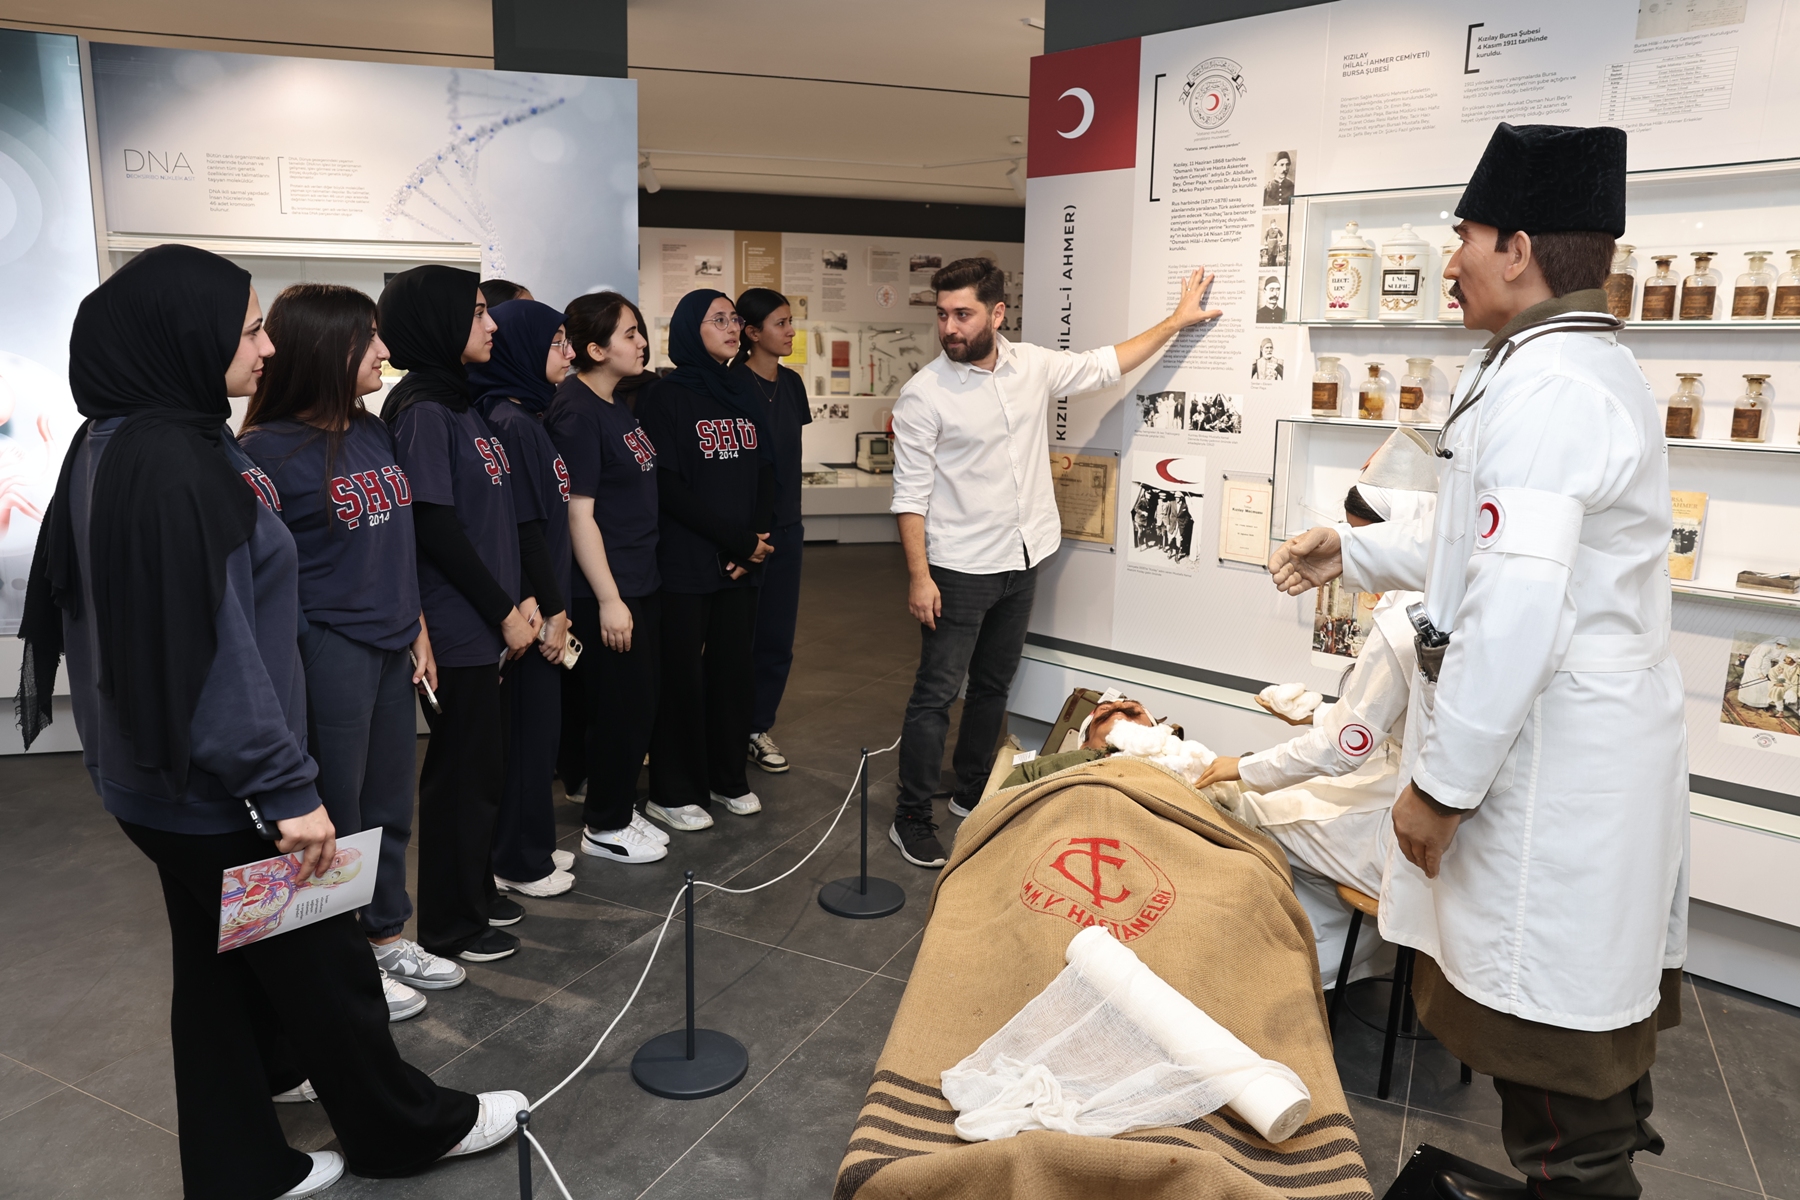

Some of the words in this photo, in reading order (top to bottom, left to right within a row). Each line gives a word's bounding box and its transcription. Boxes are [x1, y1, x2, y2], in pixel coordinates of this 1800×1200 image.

[1519, 27, 1540, 37] Şubesi
[1519, 35, 1548, 44] tarihinde
[1343, 59, 1368, 69] (HİLAL-İ
[1370, 57, 1394, 65] AHMER
[1396, 50, 1430, 62] CEMİYETİ)
[1344, 52, 1368, 60] KIZILAY
[1366, 64, 1389, 75] ŞUBESİ
[124, 149, 193, 174] DNA
[1063, 205, 1076, 279] AHMER)
[1058, 287, 1072, 350] HİLAL-İ
[1056, 396, 1068, 440] KIZIL
[719, 451, 738, 459] 2014
[330, 465, 412, 530] ŞHÜ
[369, 512, 390, 526] 2014
